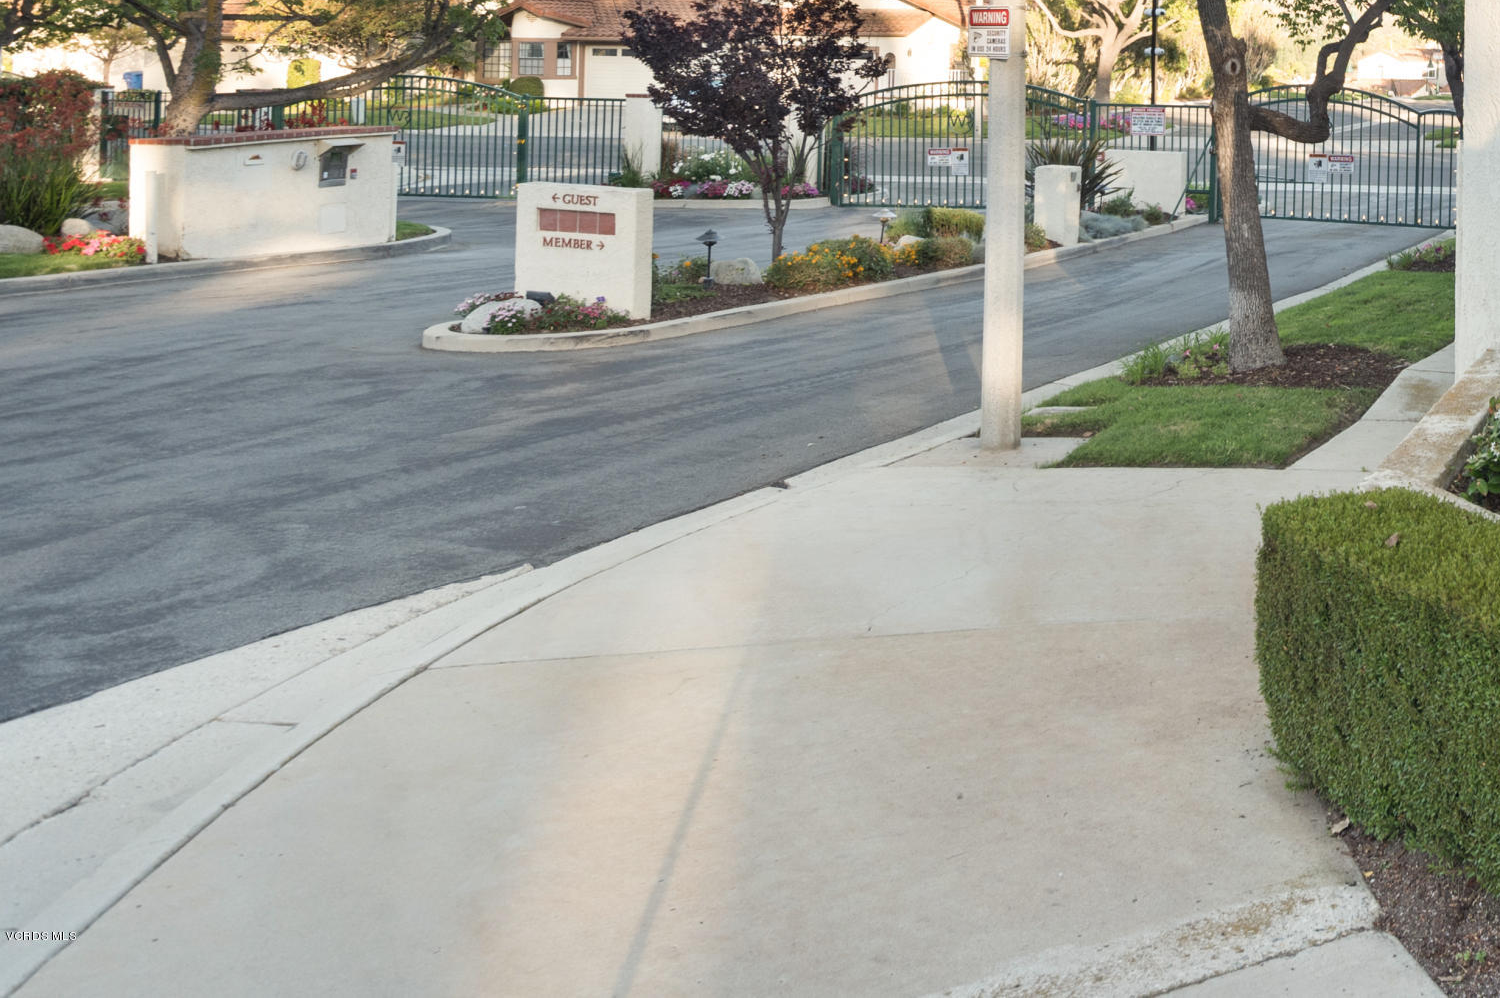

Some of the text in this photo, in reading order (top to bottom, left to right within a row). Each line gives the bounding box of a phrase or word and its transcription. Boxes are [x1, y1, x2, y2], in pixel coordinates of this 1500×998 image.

[972, 11, 1007, 24] WARNING
[562, 193, 600, 207] GUEST
[542, 236, 594, 251] MEMBER
